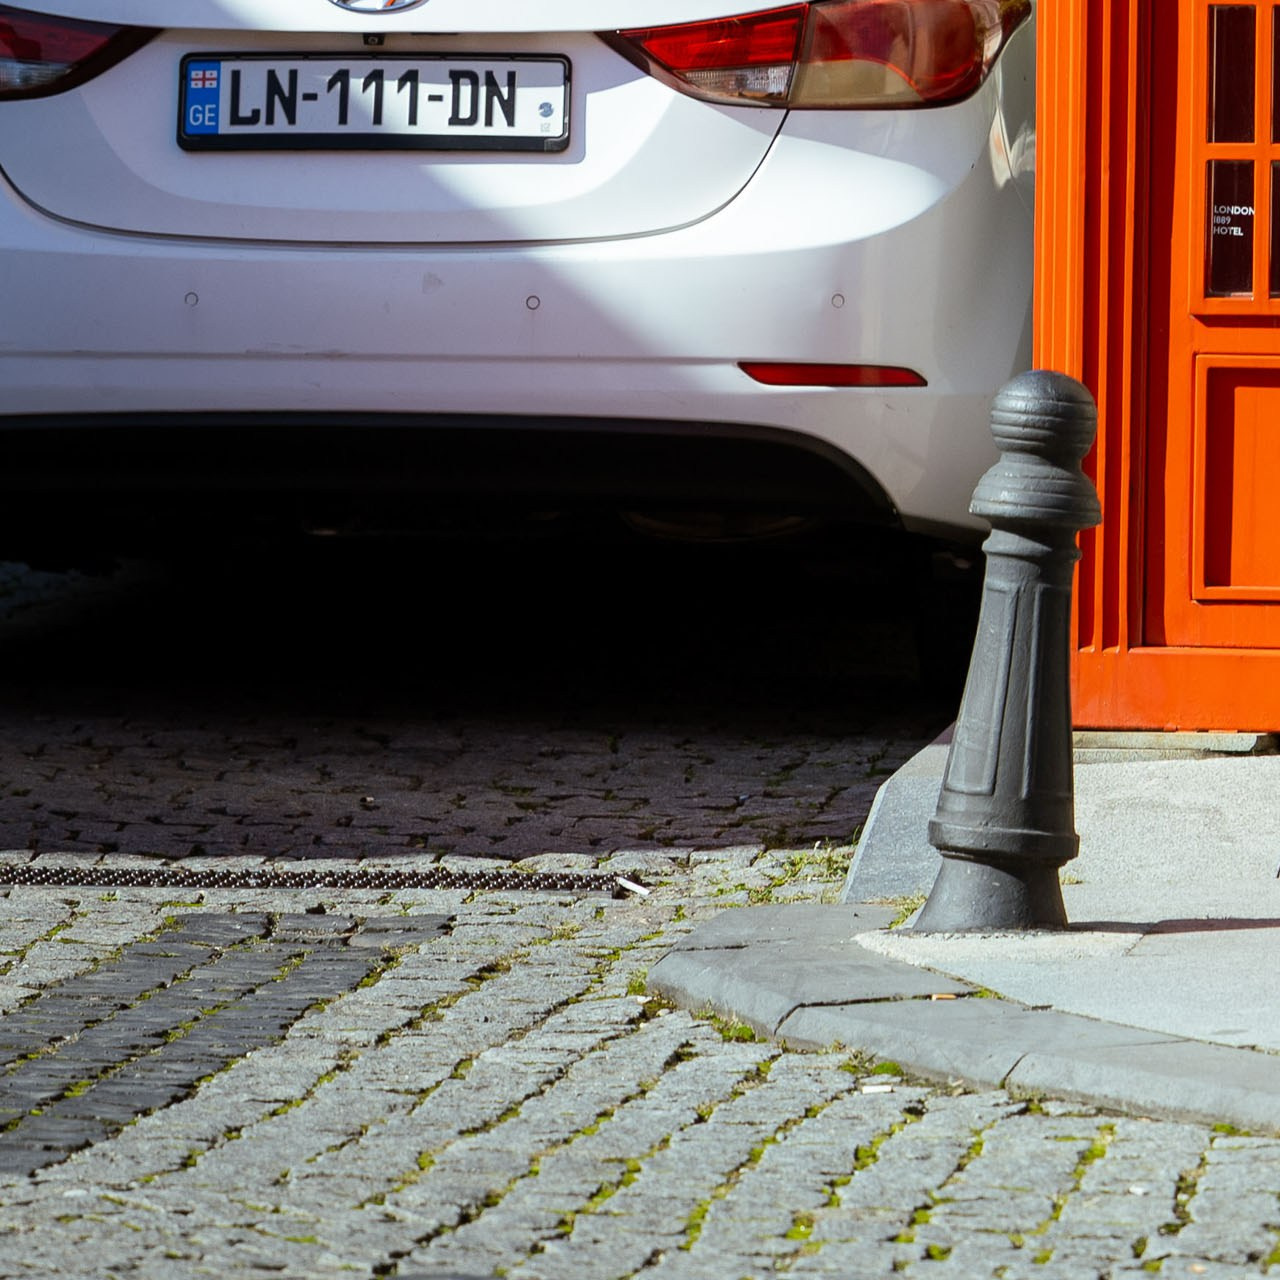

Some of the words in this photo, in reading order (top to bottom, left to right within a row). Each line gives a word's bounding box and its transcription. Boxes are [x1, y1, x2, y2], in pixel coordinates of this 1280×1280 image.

[229, 69, 517, 127] LN-111-DN
[189, 104, 216, 126] GE
[1214, 205, 1255, 215] LONDON
[1213, 226, 1244, 236] HOTEL
